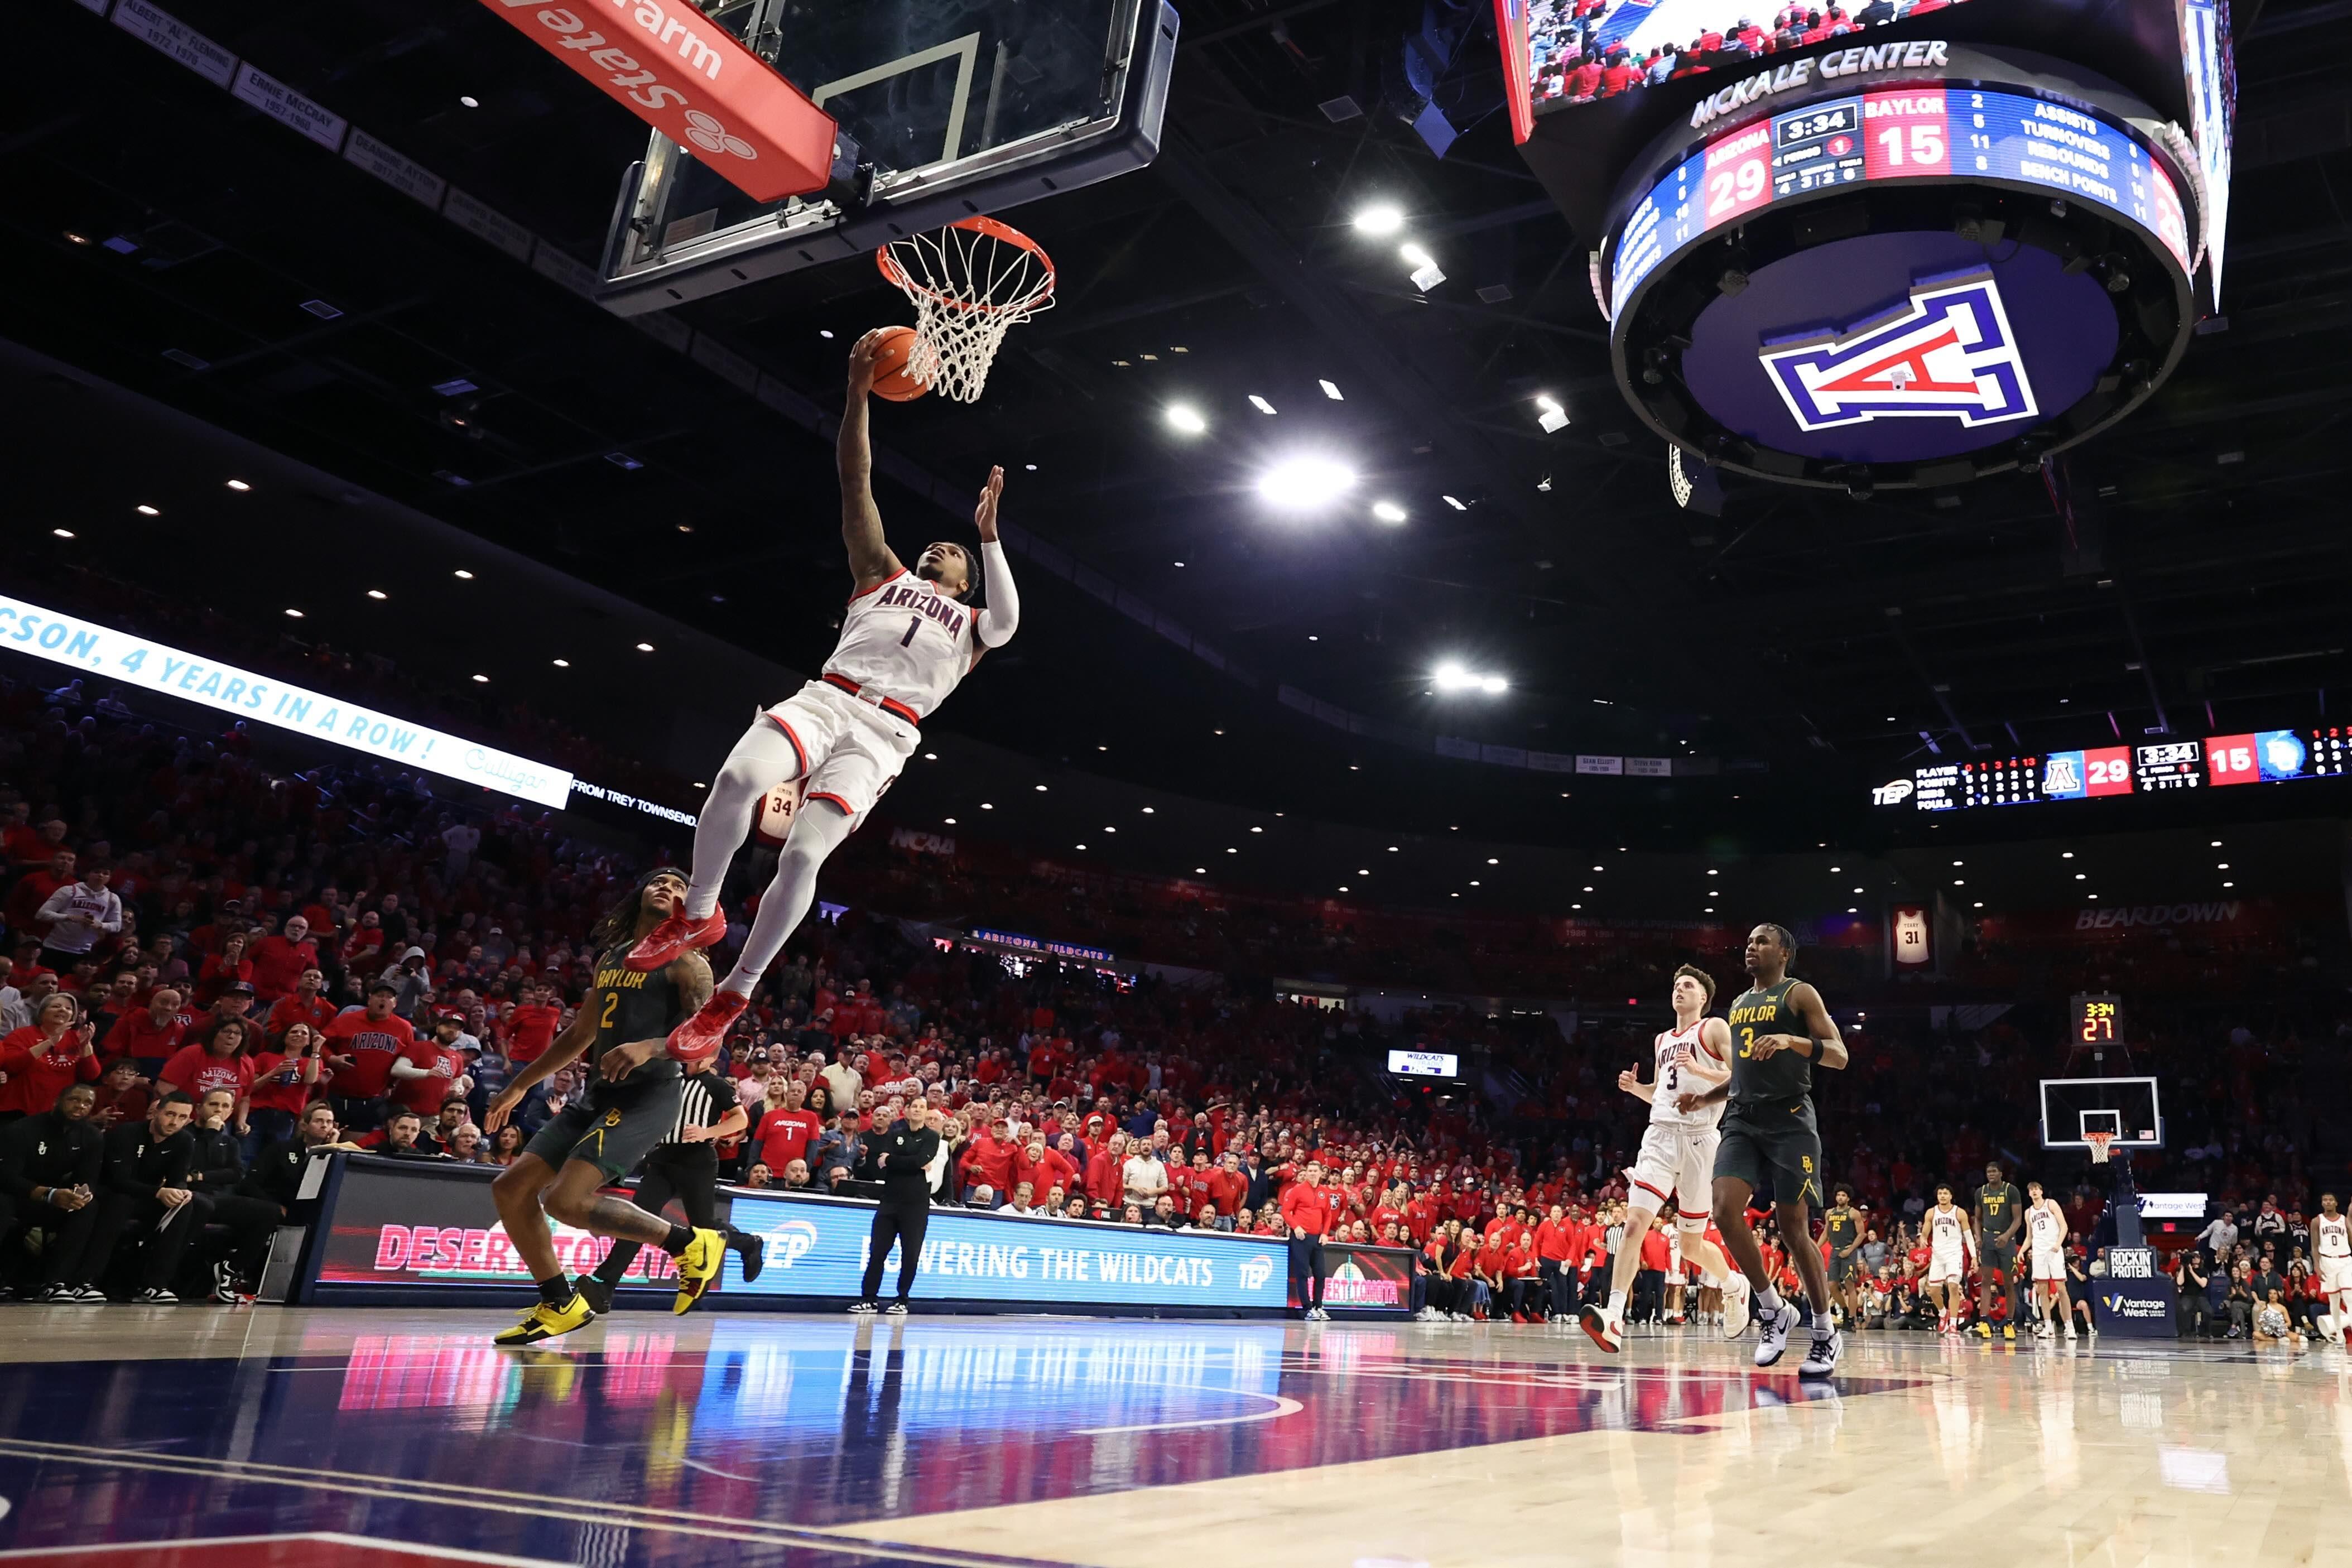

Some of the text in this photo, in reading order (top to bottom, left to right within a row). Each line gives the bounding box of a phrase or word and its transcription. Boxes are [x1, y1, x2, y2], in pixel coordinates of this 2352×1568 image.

[124, 0, 162, 26] ALBERT
[611, 0, 723, 81] arm
[537, 8, 688, 109] State
[1819, 40, 1949, 78] CENTER
[249, 73, 282, 99] ERNIE
[1865, 97, 1944, 118] BAYLOR
[1971, 94, 1983, 108] 2
[1788, 111, 1846, 139] 3:34
[1973, 114, 1985, 128] 5
[2034, 103, 2096, 135] ASSISTS
[1706, 128, 1769, 170] ARIZONA
[1834, 140, 1844, 152] 1
[1879, 125, 1944, 166] 15
[1970, 134, 1990, 150] 11
[2021, 119, 2110, 160] TURNOVERS
[1976, 155, 1988, 170] 8
[2027, 141, 2109, 179] REBOUNDS
[1709, 158, 1766, 217] 29
[1801, 176, 1812, 189] 3
[1823, 171, 1834, 184] 2
[2021, 161, 2118, 204] BENCH POINTS
[1779, 182, 1790, 194] 4
[2134, 203, 2147, 220] 11
[874, 585, 964, 643] ARIZONA
[901, 615, 922, 648] 1
[120, 648, 148, 673] 4
[160, 657, 268, 708] YEARS
[273, 693, 312, 722] IN
[316, 708, 339, 732] A
[346, 716, 417, 753] ROW
[2313, 729, 2320, 738] 1
[2330, 728, 2339, 737] 2
[2144, 744, 2194, 764] 3:34
[2211, 748, 2251, 773] 15
[465, 748, 548, 792] Culligan
[1916, 766, 1958, 778] PLAYER
[1980, 762, 1987, 771] 1
[2009, 759, 2017, 768] 4
[2022, 757, 2036, 767] 13
[2089, 759, 2129, 785] 29
[2334, 763, 2342, 773] 1
[570, 779, 605, 799] FROM
[607, 790, 636, 807] TREY
[1872, 786, 1910, 805] TEP
[1981, 784, 1988, 792] 1
[772, 797, 792, 816] 34
[1917, 798, 1953, 810] FOULS
[2028, 792, 2034, 800] 1
[889, 827, 955, 855] NCAA
[983, 932, 1104, 960] ARIZONA WILDCATS
[1906, 931, 1919, 944] 31
[597, 969, 648, 989] BAYLOR
[601, 992, 618, 1028] 2
[1729, 1005, 1776, 1027] BAYLOR
[2086, 1003, 2114, 1017] 3:34
[2083, 1018, 2111, 1041] 27
[1739, 1027, 1754, 1058] 3
[202, 1070, 237, 1083] ARIZONA
[1667, 1065, 1677, 1090] 3
[774, 1120, 807, 1128] ARIZONA
[786, 1127, 793, 1140] 1
[1990, 1204, 1999, 1216] 17
[2032, 1212, 2050, 1223] ARIZONA
[1832, 1221, 1840, 1232] 15
[1935, 1217, 1955, 1226] ARIZONA
[1942, 1226, 1947, 1237] 4
[2037, 1221, 2045, 1230] 13
[2331, 1235, 2337, 1245] 0
[1039, 1248, 1089, 1281] THE
[1098, 1251, 1213, 1287] WILDCATS
[2110, 1252, 2152, 1266] ROCKIN'
[1239, 1262, 1269, 1290] TEP
[2111, 1266, 2152, 1278] PROTEIN
[1351, 1280, 1398, 1304] TOYOTA
[2123, 1299, 2165, 1309] Vantage
[2123, 1308, 2148, 1317] West
